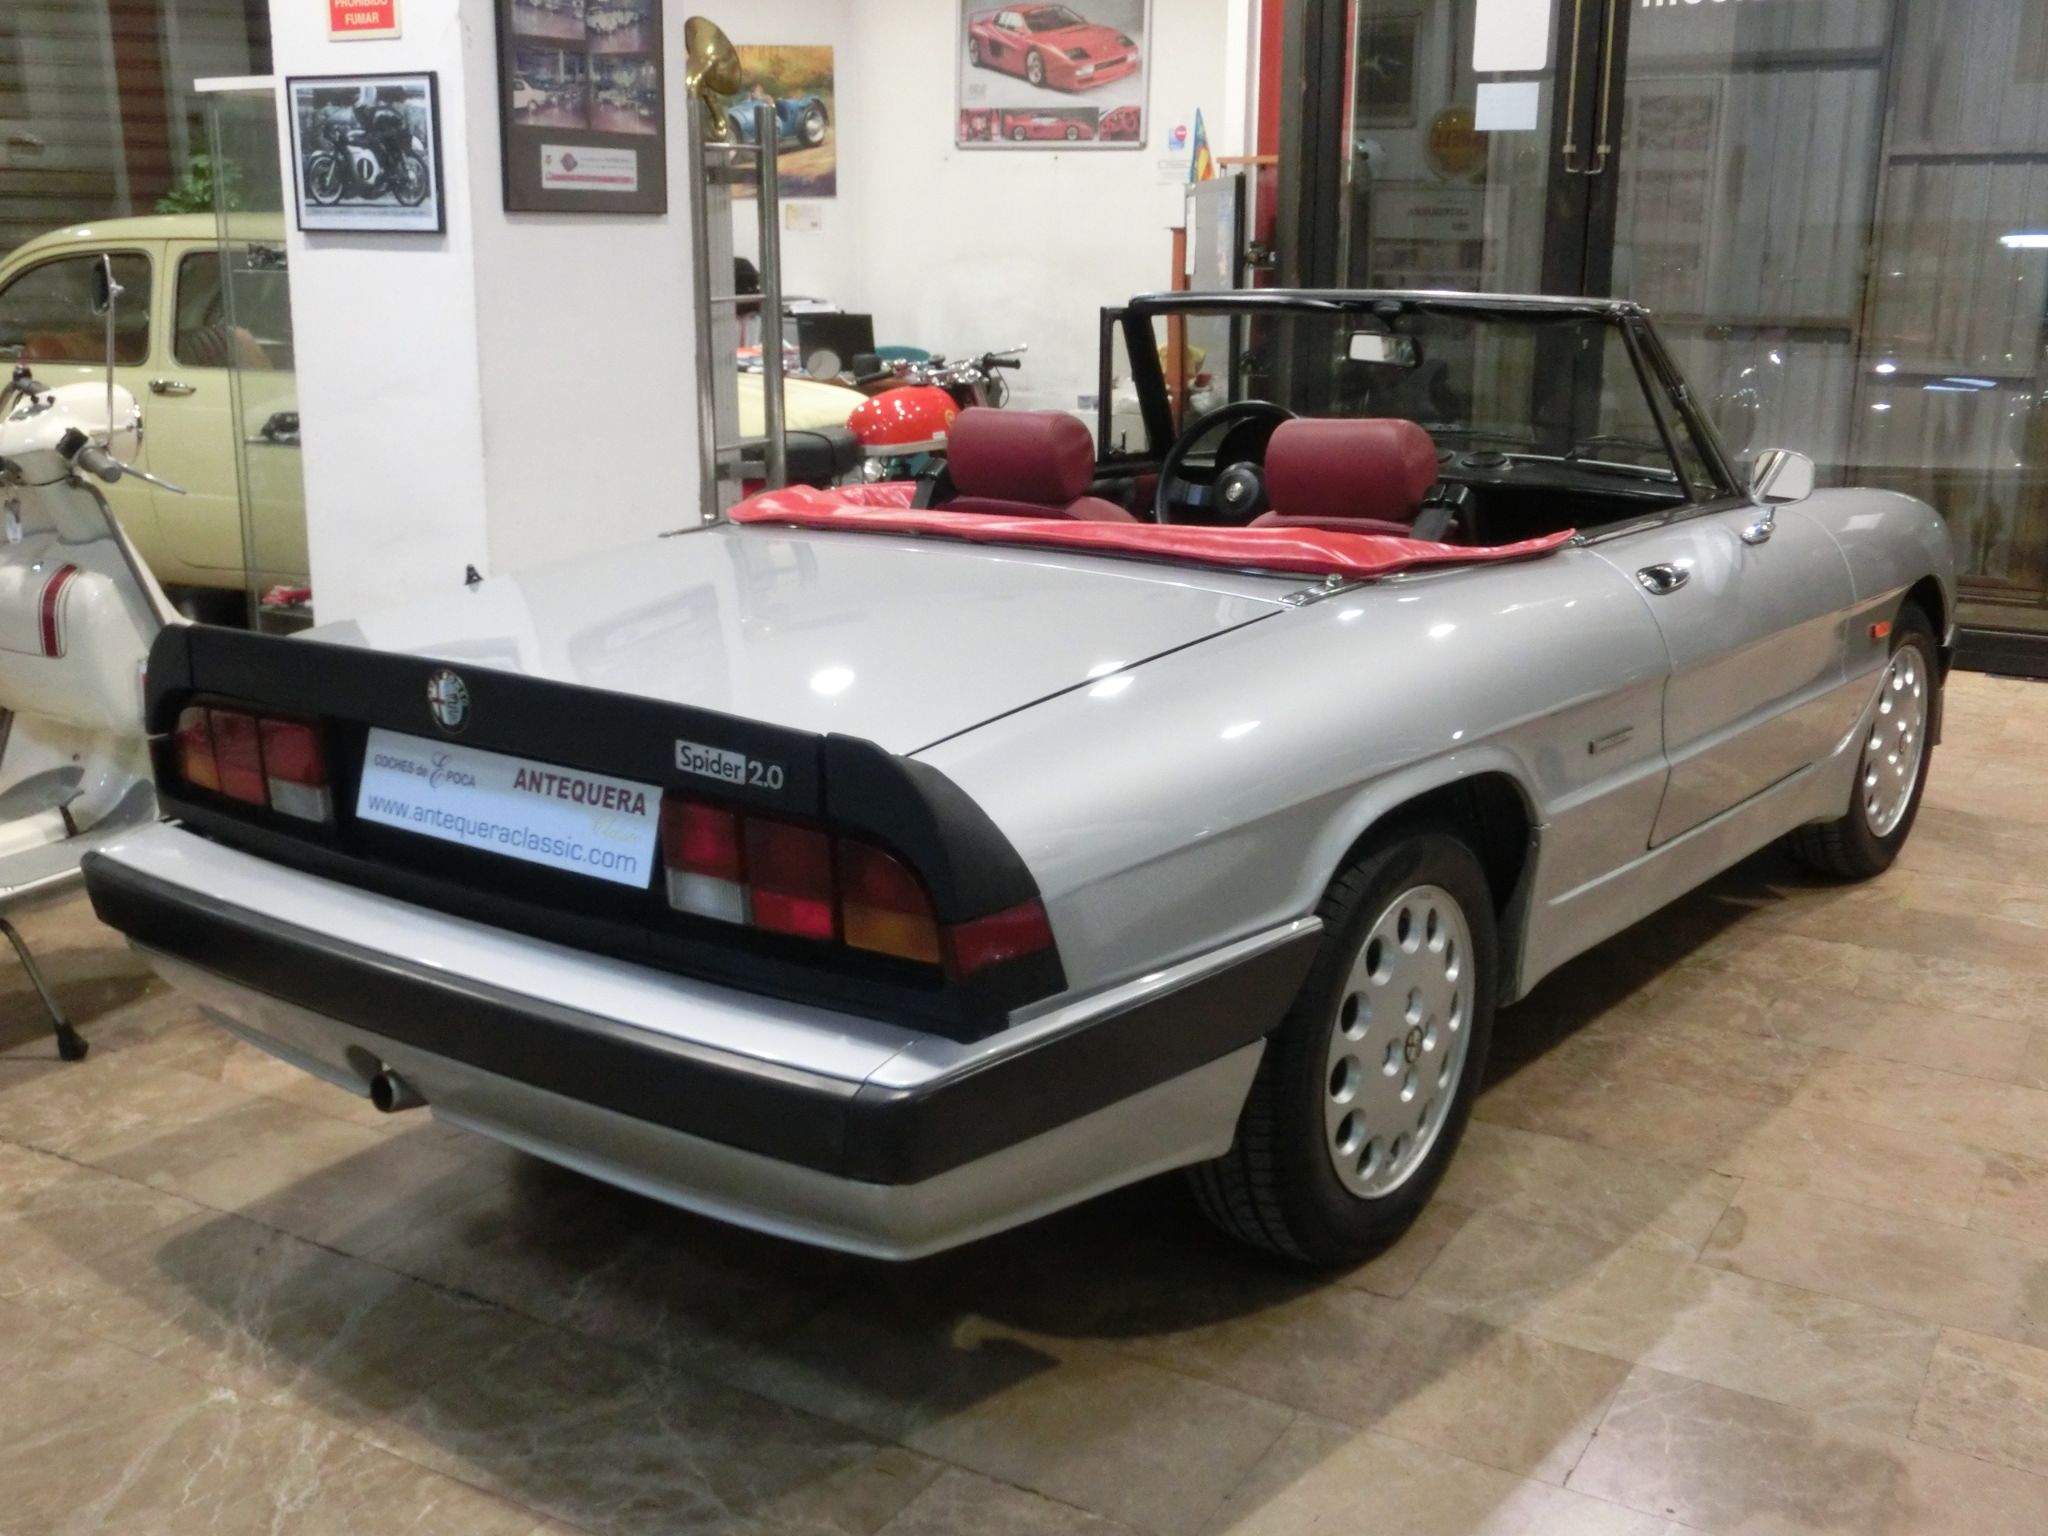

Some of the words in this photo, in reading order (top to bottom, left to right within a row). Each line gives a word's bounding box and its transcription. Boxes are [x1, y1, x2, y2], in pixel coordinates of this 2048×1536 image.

[344, 12, 380, 25] FUMAR
[680, 745, 742, 779] Spider
[747, 760, 784, 790] 2.0
[513, 767, 647, 816] ANTEQUERA
[367, 794, 638, 875] www.antequeraclassic.com
